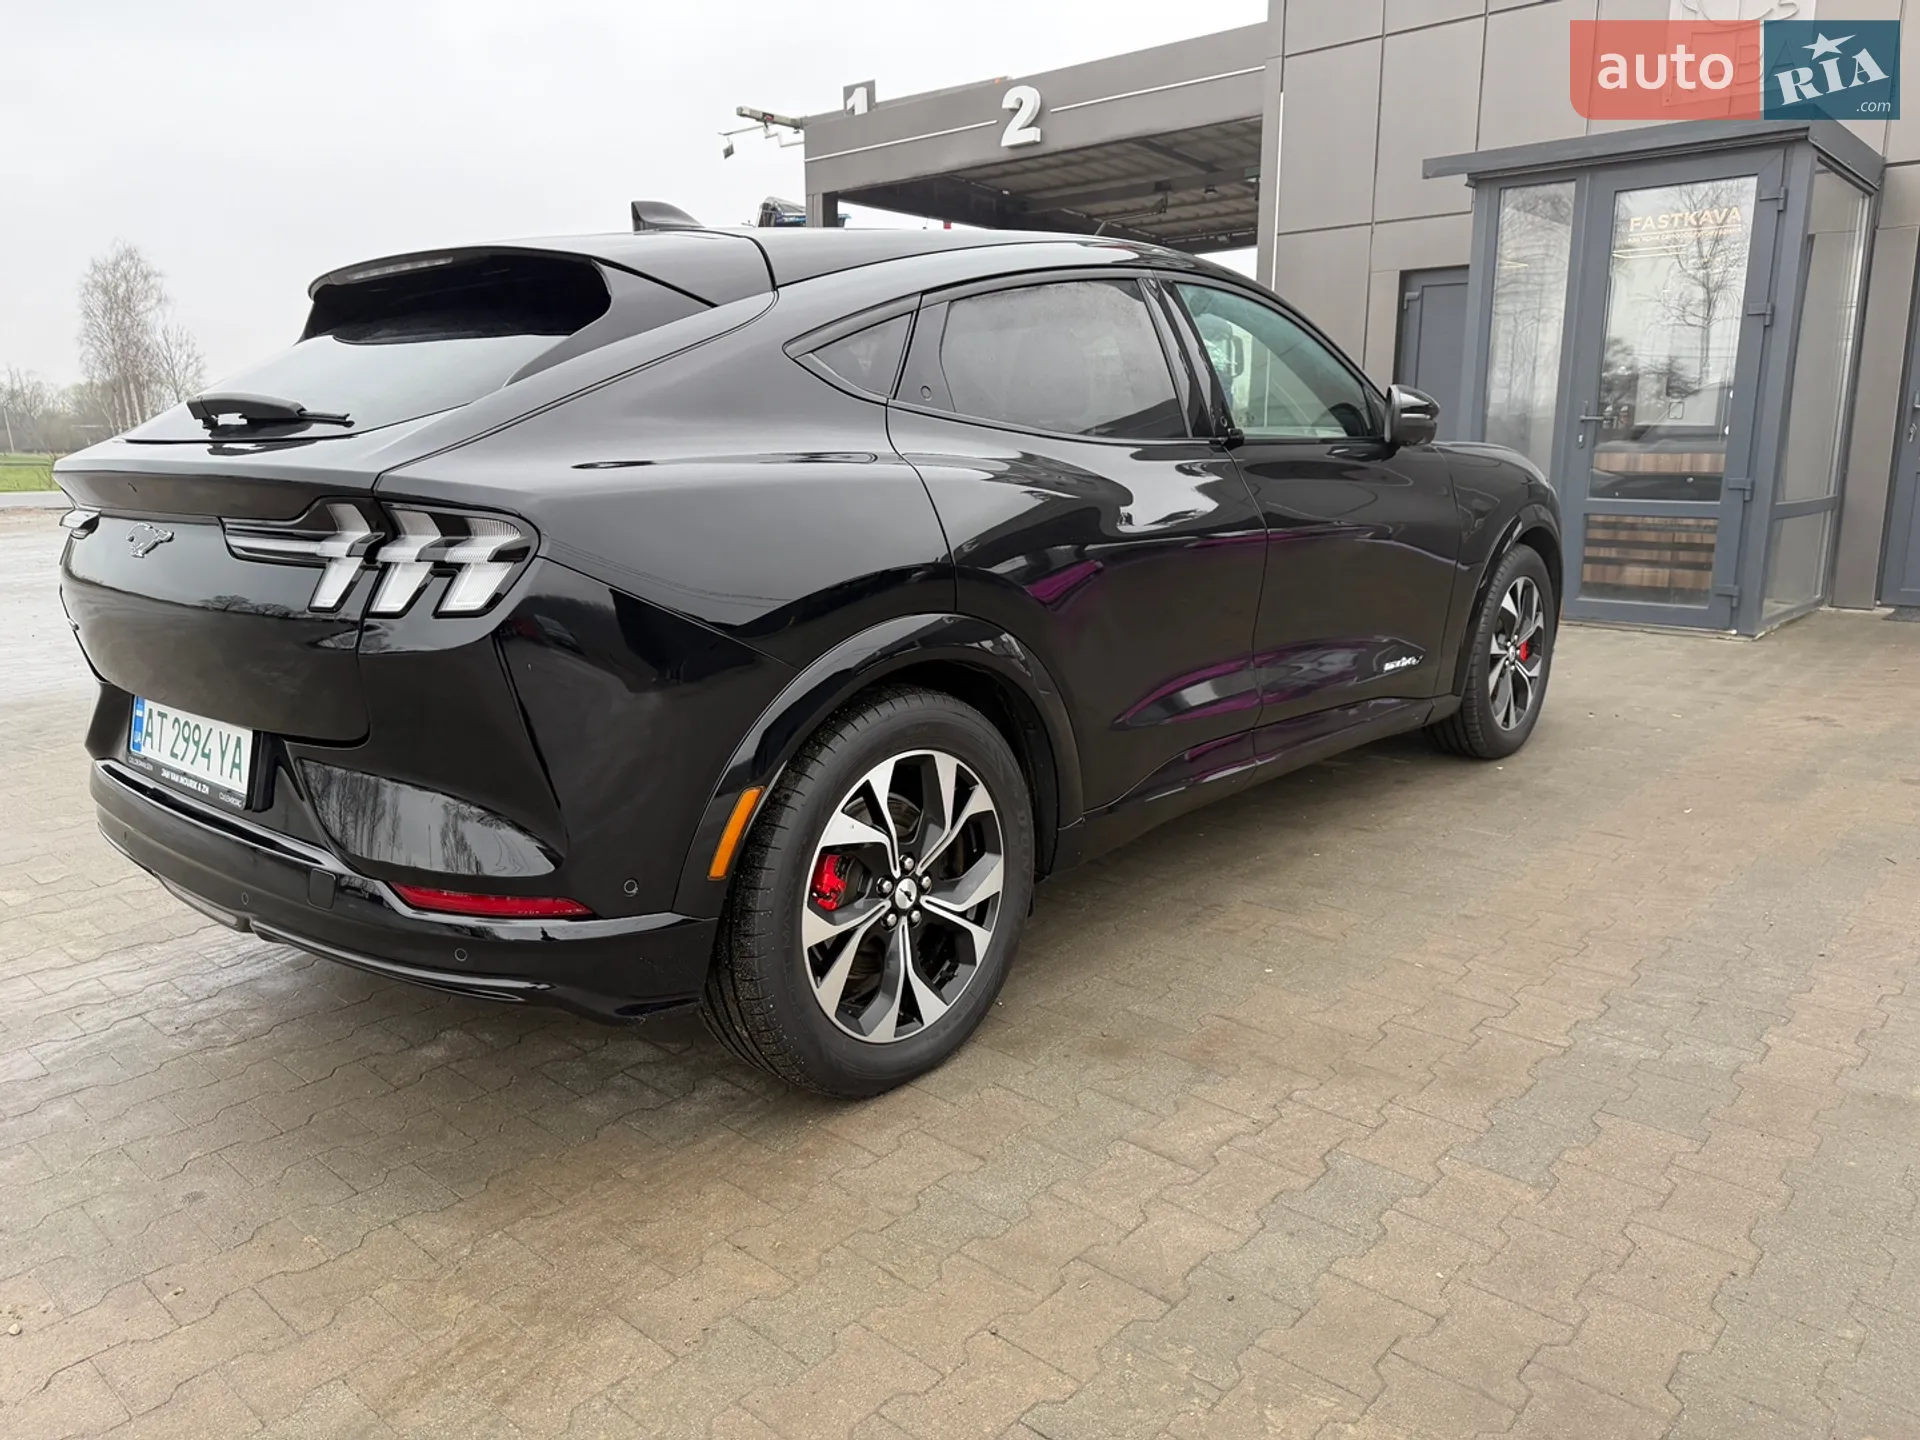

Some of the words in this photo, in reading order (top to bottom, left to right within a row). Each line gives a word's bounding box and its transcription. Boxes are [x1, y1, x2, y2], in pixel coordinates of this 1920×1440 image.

[846, 86, 869, 116] 1
[1000, 85, 1041, 148] 2
[1629, 206, 1742, 233] FASTKAVA
[143, 707, 168, 752] AT
[169, 717, 214, 772] 2994
[218, 730, 243, 784] YA
